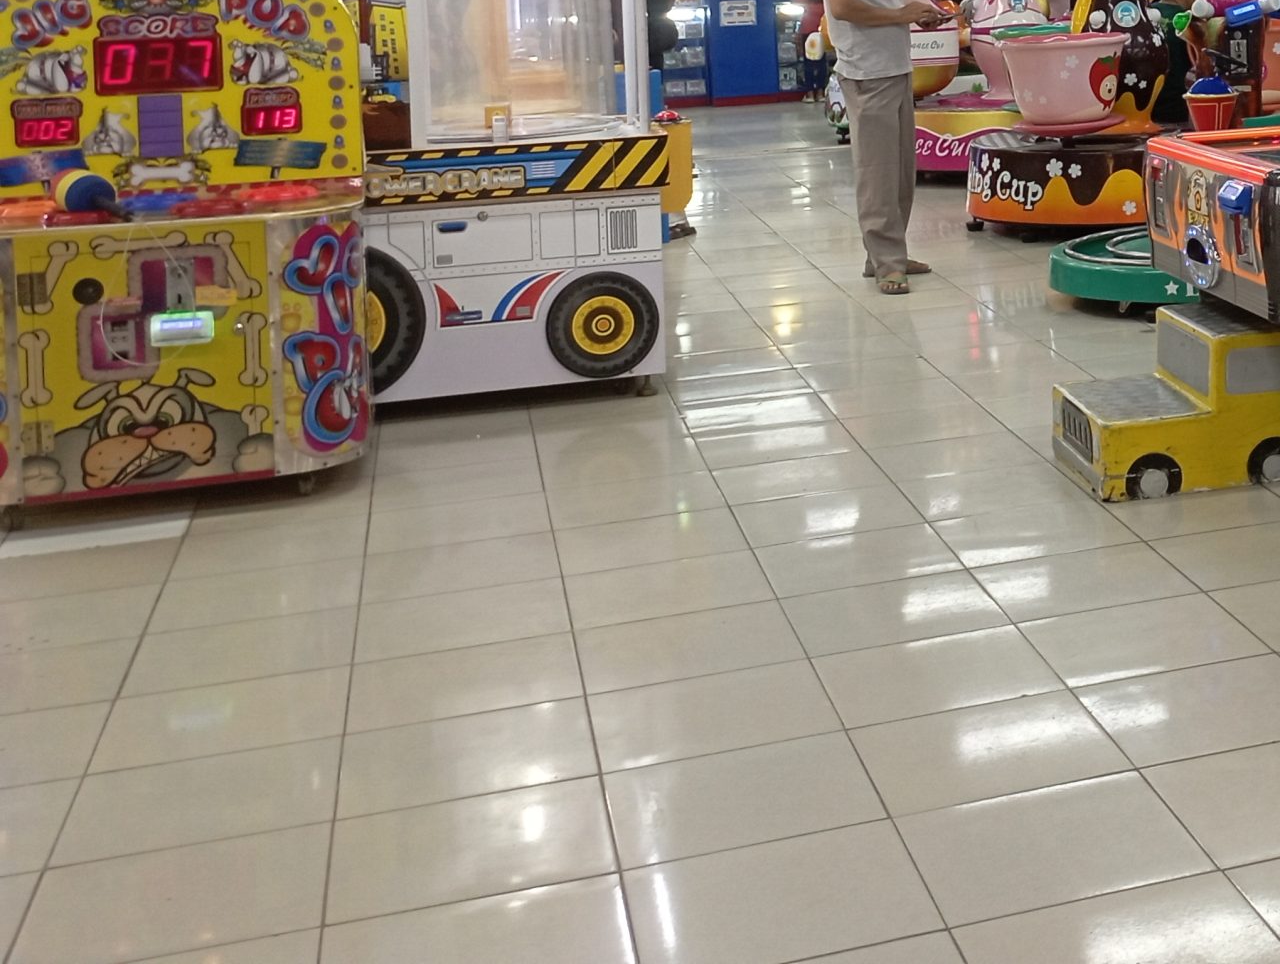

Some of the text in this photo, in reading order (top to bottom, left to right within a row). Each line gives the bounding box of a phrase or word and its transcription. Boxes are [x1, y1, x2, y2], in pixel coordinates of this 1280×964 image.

[101, 14, 217, 36] SCORE
[258, 108, 296, 128] 113
[22, 120, 72, 140] 002
[441, 167, 525, 194] CRANE
[997, 171, 1043, 210] Cup
